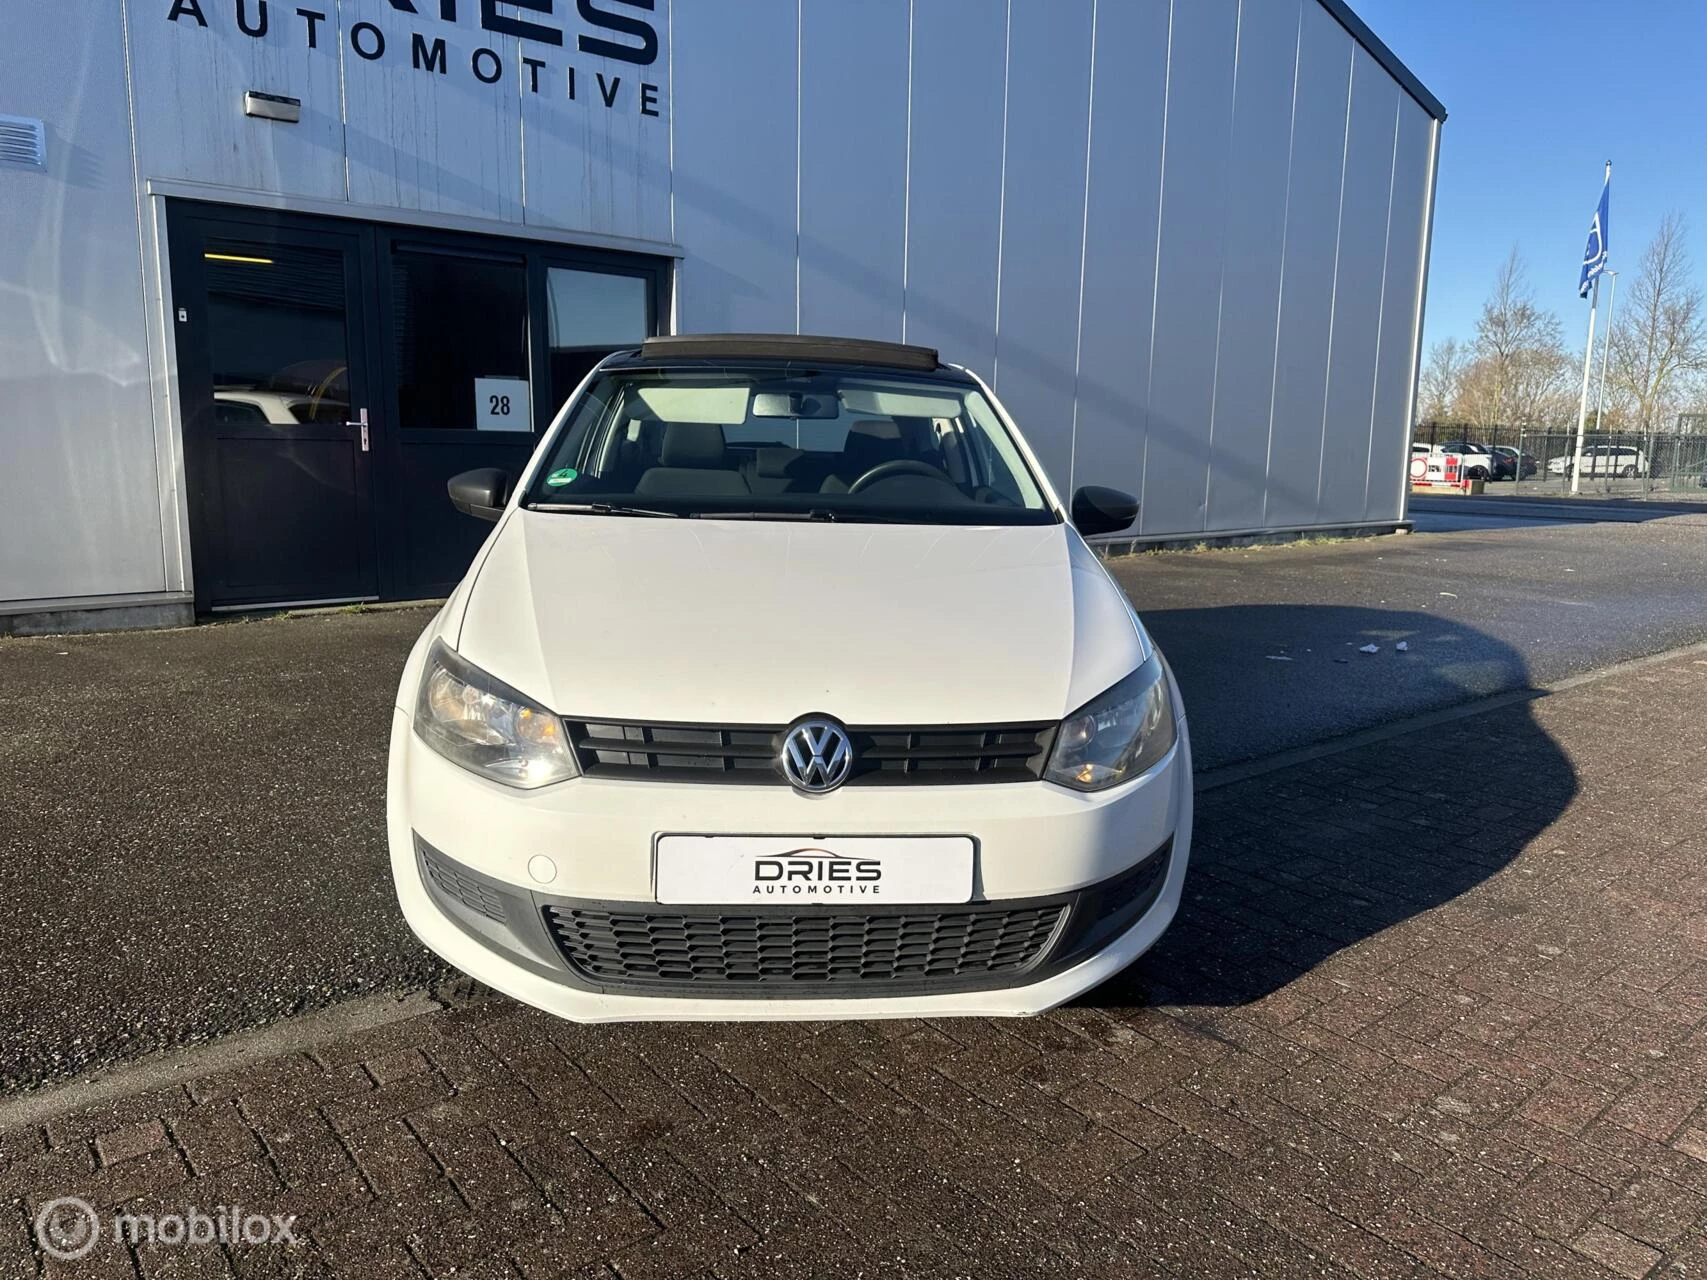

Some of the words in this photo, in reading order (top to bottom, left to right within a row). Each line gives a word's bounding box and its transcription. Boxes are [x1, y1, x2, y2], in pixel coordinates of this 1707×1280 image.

[167, 0, 659, 117] AUTOMOTIVE
[489, 394, 511, 416] 28
[755, 860, 882, 881] DRIES
[753, 885, 880, 894] AUTOMOTIVE
